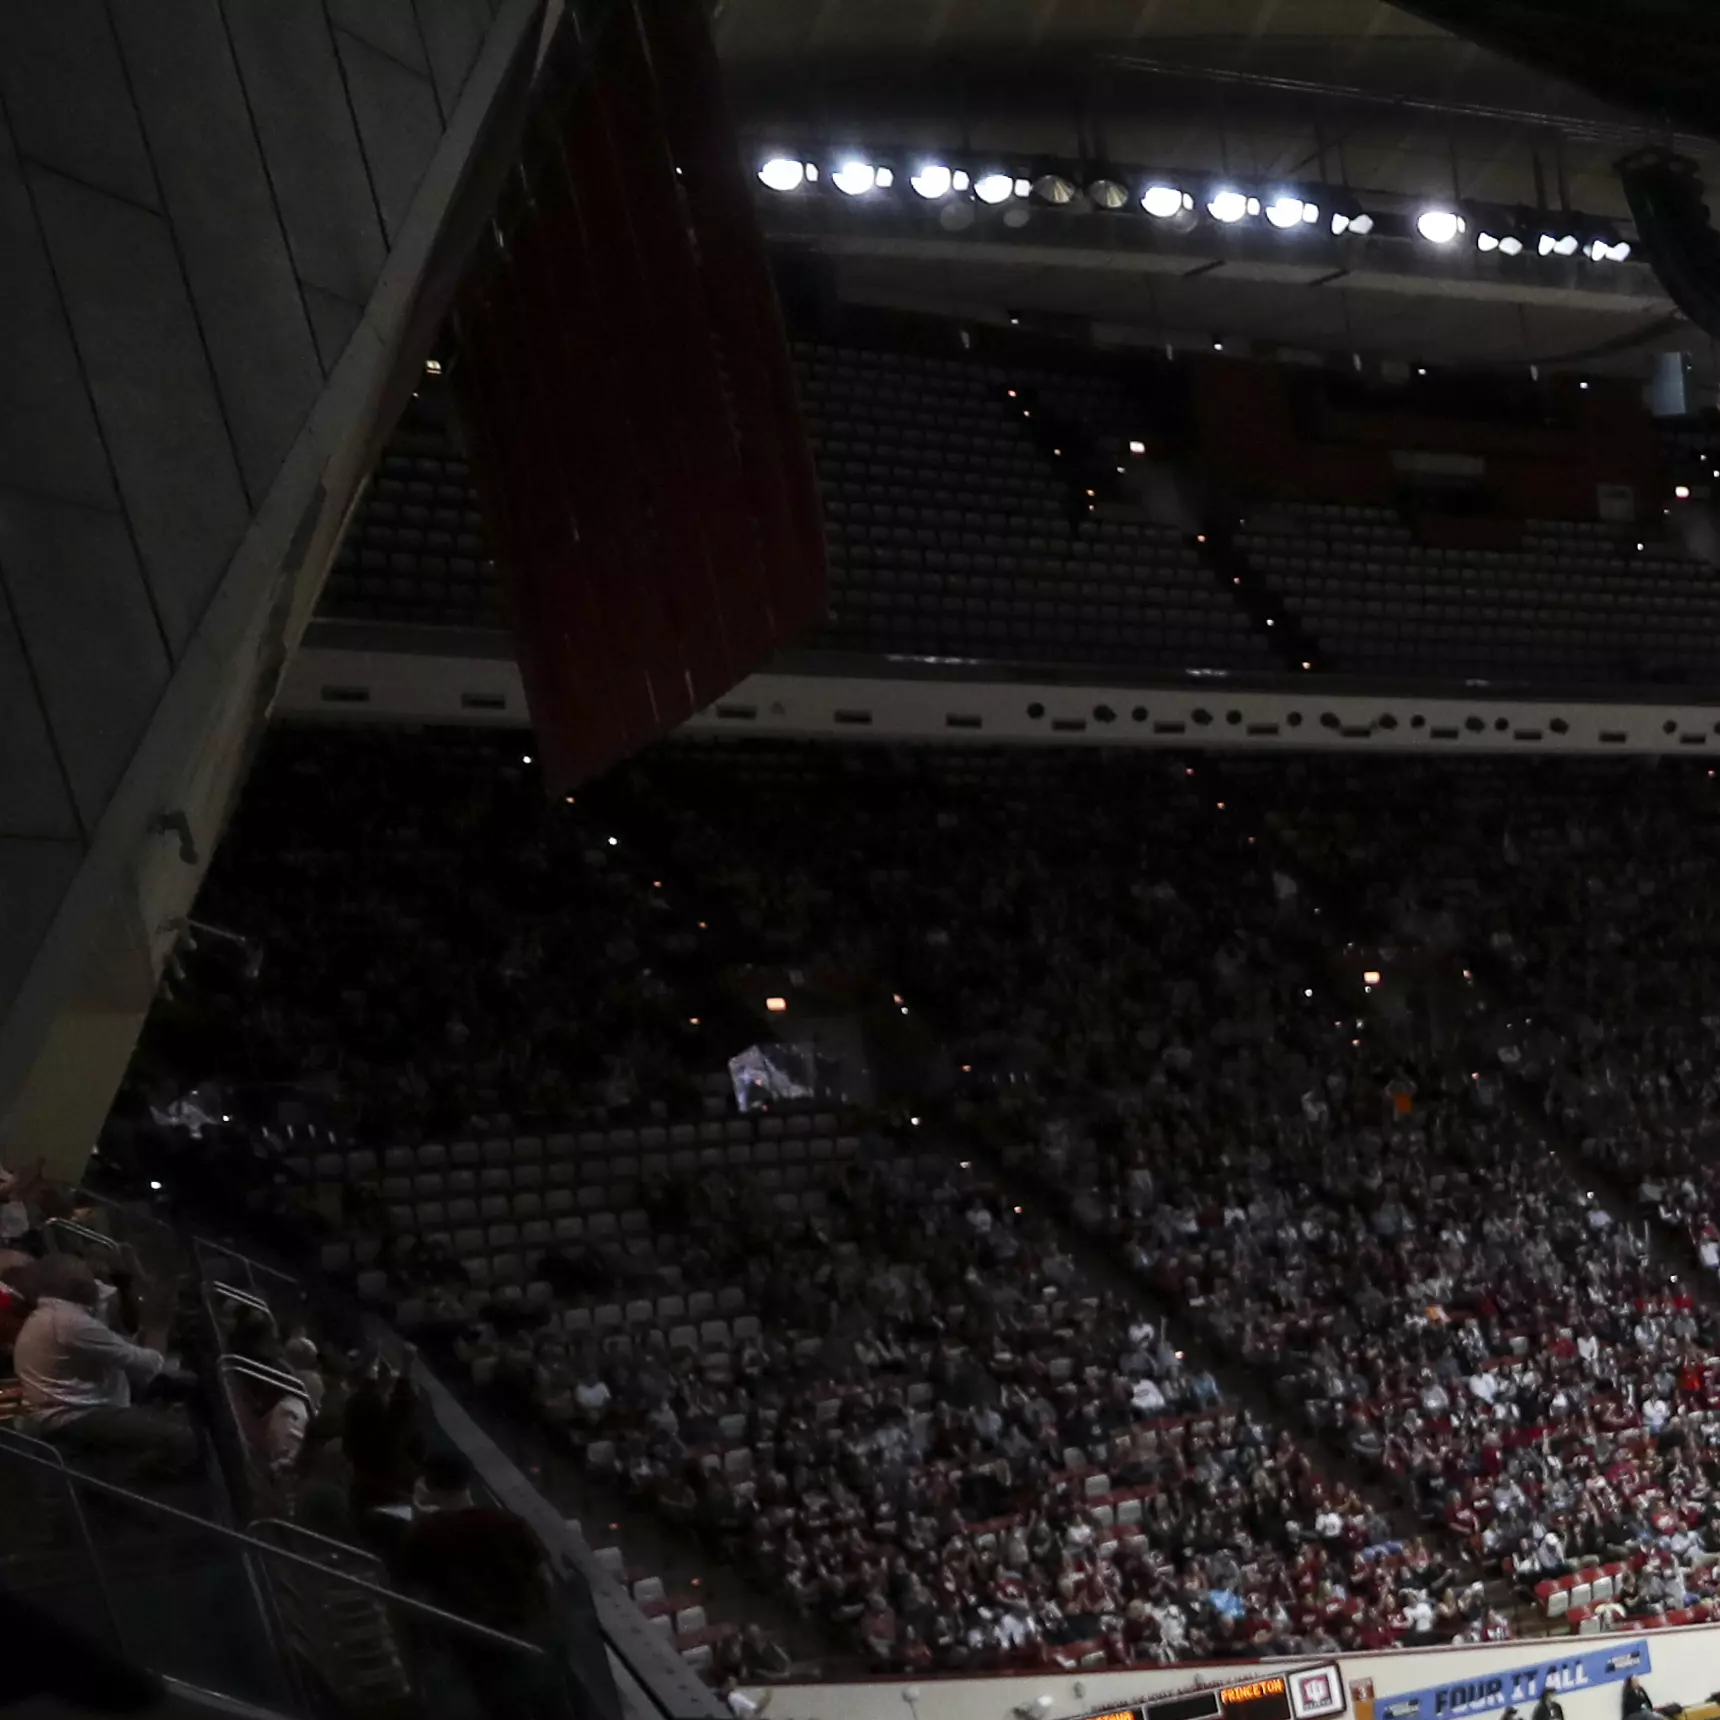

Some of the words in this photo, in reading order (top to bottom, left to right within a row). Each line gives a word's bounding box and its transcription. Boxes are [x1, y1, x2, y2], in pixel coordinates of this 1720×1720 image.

[1221, 1678, 1283, 1704] PRINCETON
[1435, 1675, 1505, 1717] FOUR
[1511, 1668, 1539, 1700] IT
[1545, 1659, 1589, 1687] ALL
